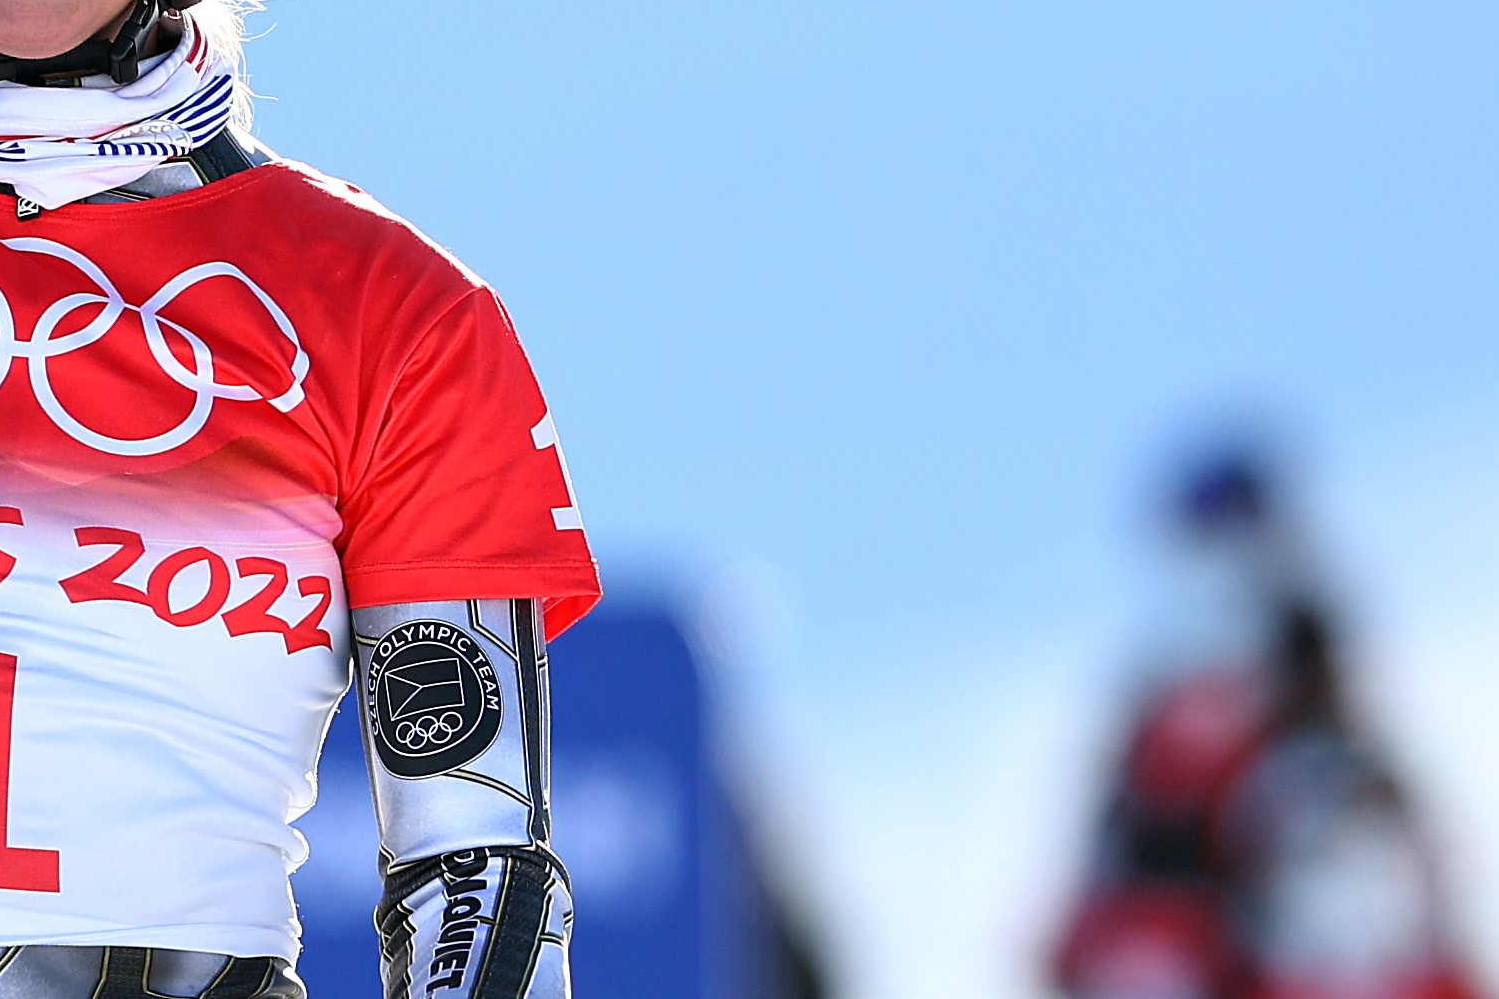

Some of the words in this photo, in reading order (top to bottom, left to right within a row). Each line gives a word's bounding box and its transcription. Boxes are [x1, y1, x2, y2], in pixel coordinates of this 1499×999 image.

[58, 526, 334, 656] 2022
[368, 661, 381, 736] CZECH
[379, 624, 471, 658] OLYMPIC
[472, 651, 500, 711] TEAM
